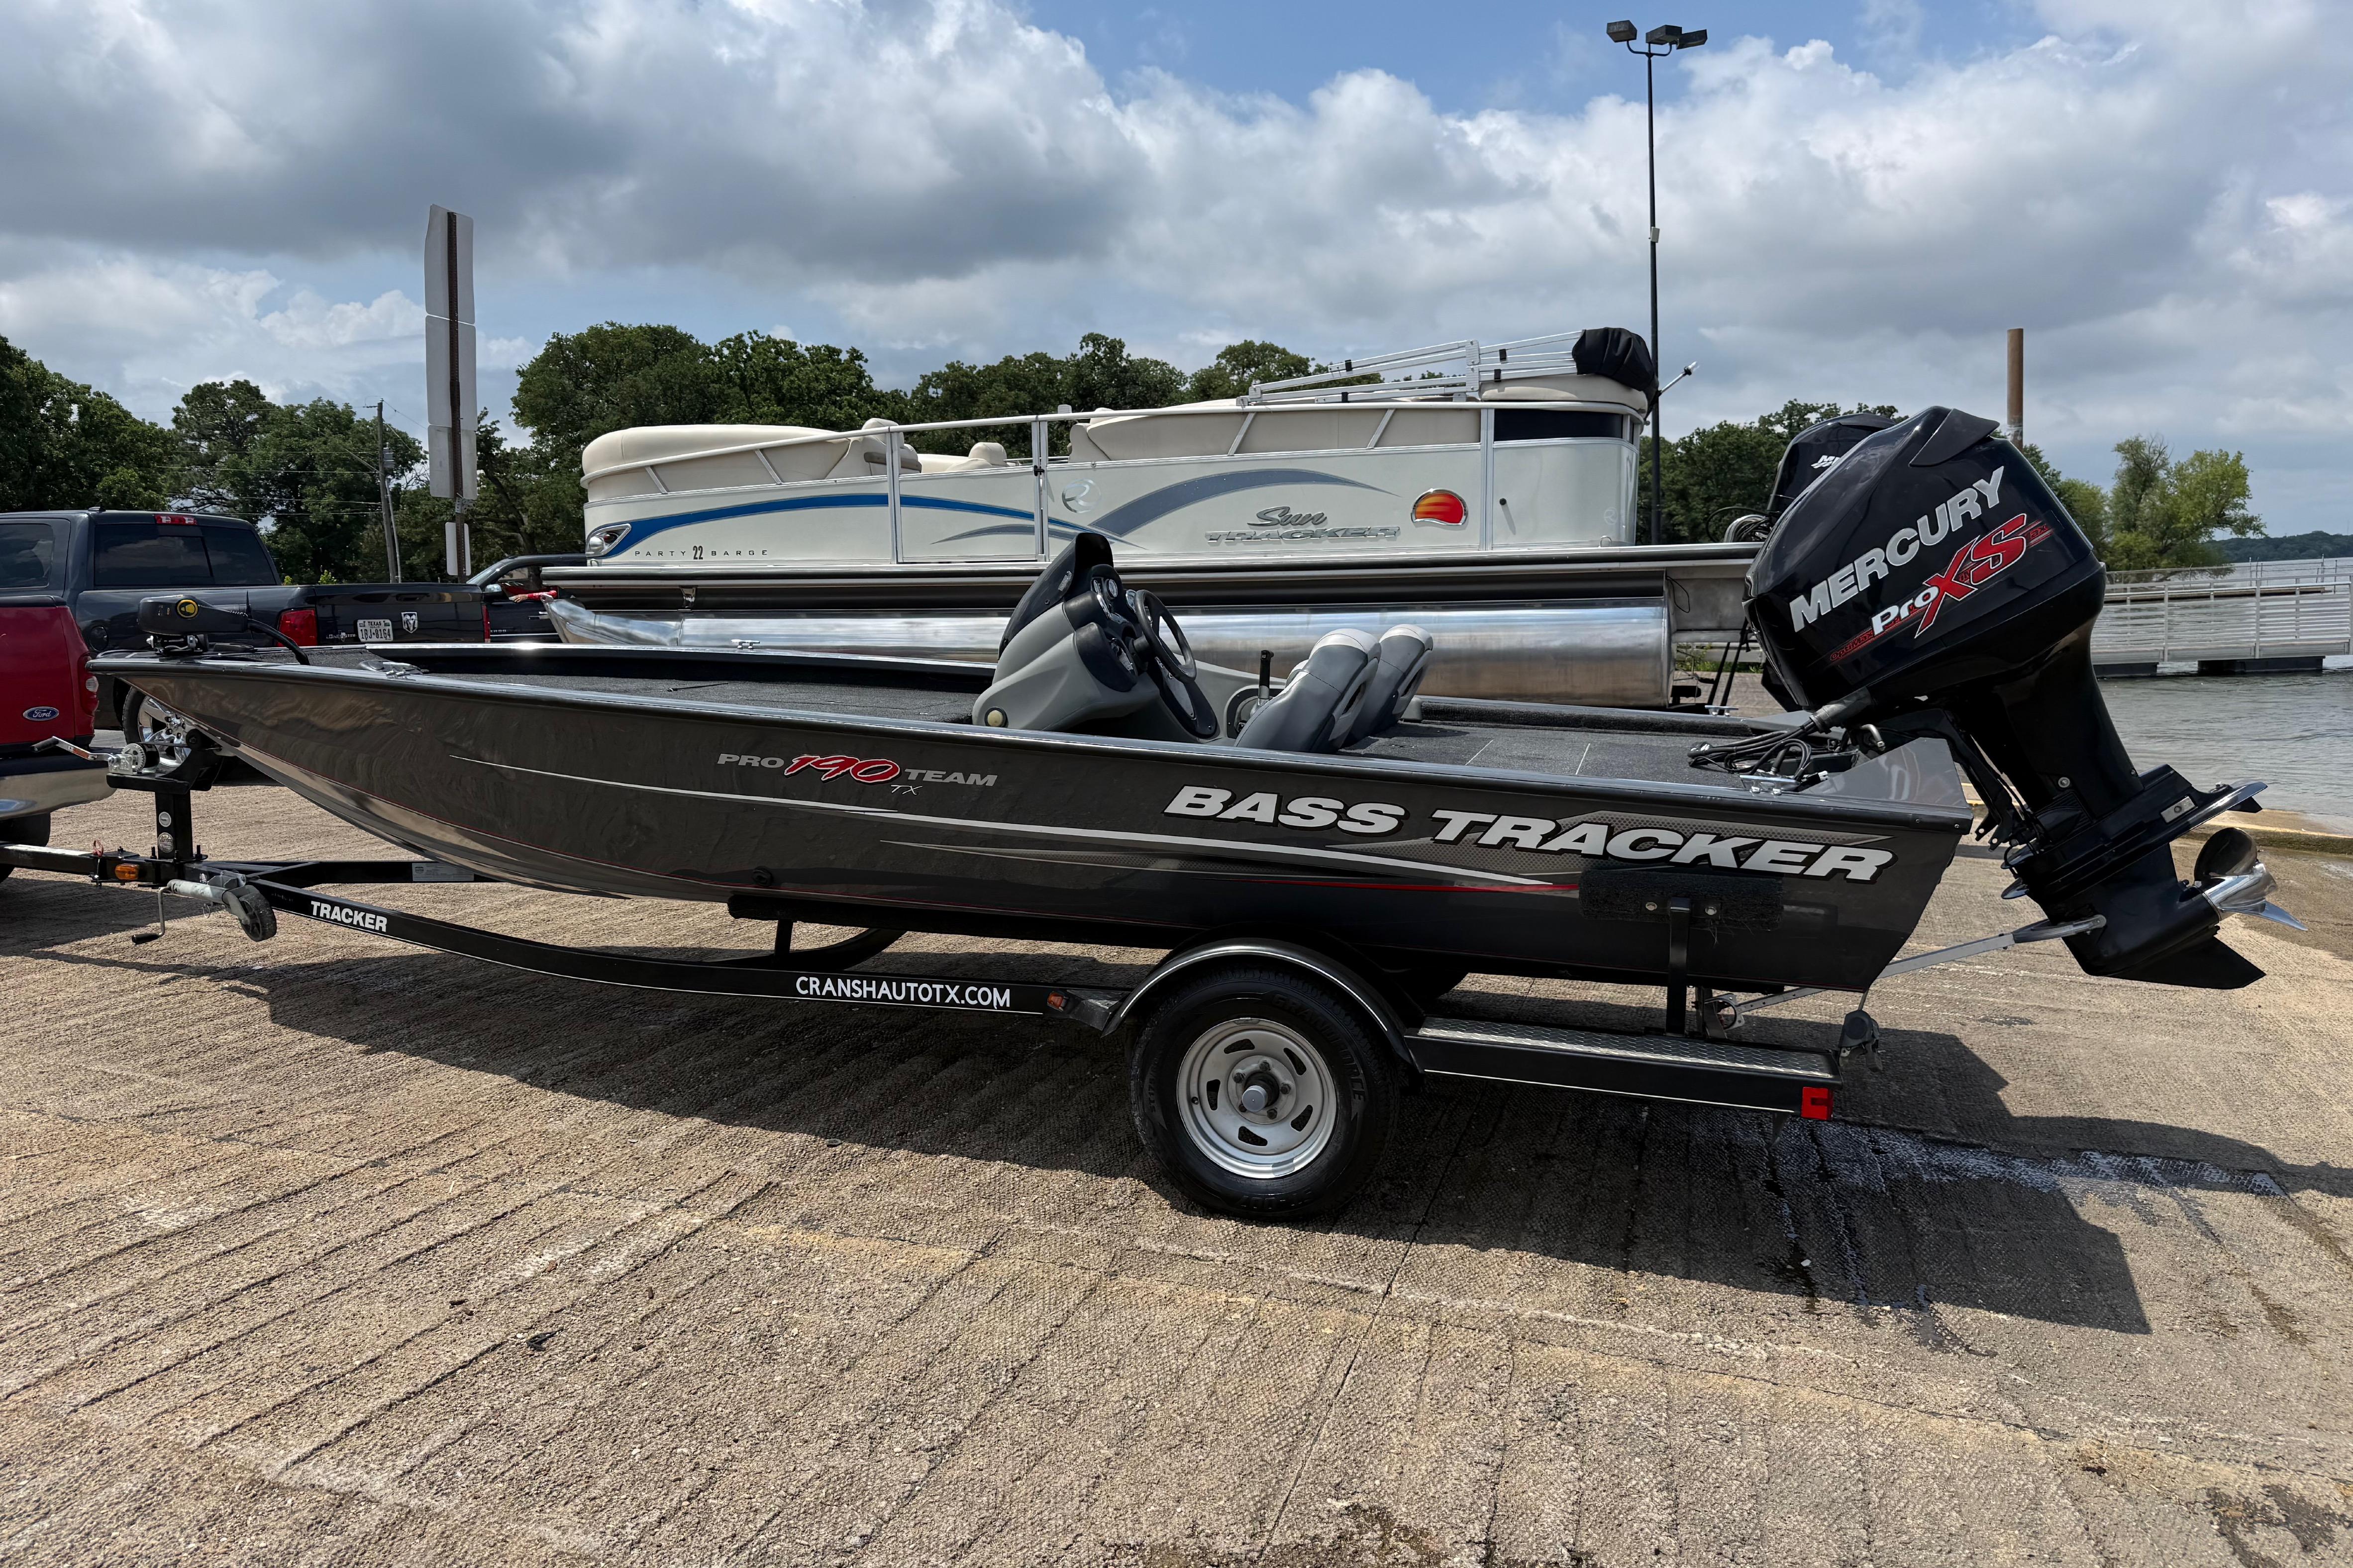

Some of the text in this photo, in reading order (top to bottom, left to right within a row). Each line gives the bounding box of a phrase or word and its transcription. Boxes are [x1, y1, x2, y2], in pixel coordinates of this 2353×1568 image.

[1247, 506, 1327, 526] Sun
[1205, 526, 1400, 542] TRACKER
[1789, 466, 2004, 633] MERCURY
[693, 546, 704, 560] 22
[716, 753, 998, 787] PRO 190 TEAM
[890, 784, 922, 795] TX
[1162, 784, 1895, 881] BASS TRACKER
[310, 900, 387, 932] TRACKER
[796, 976, 1010, 1008] CRANSHAUTOTX.COM
